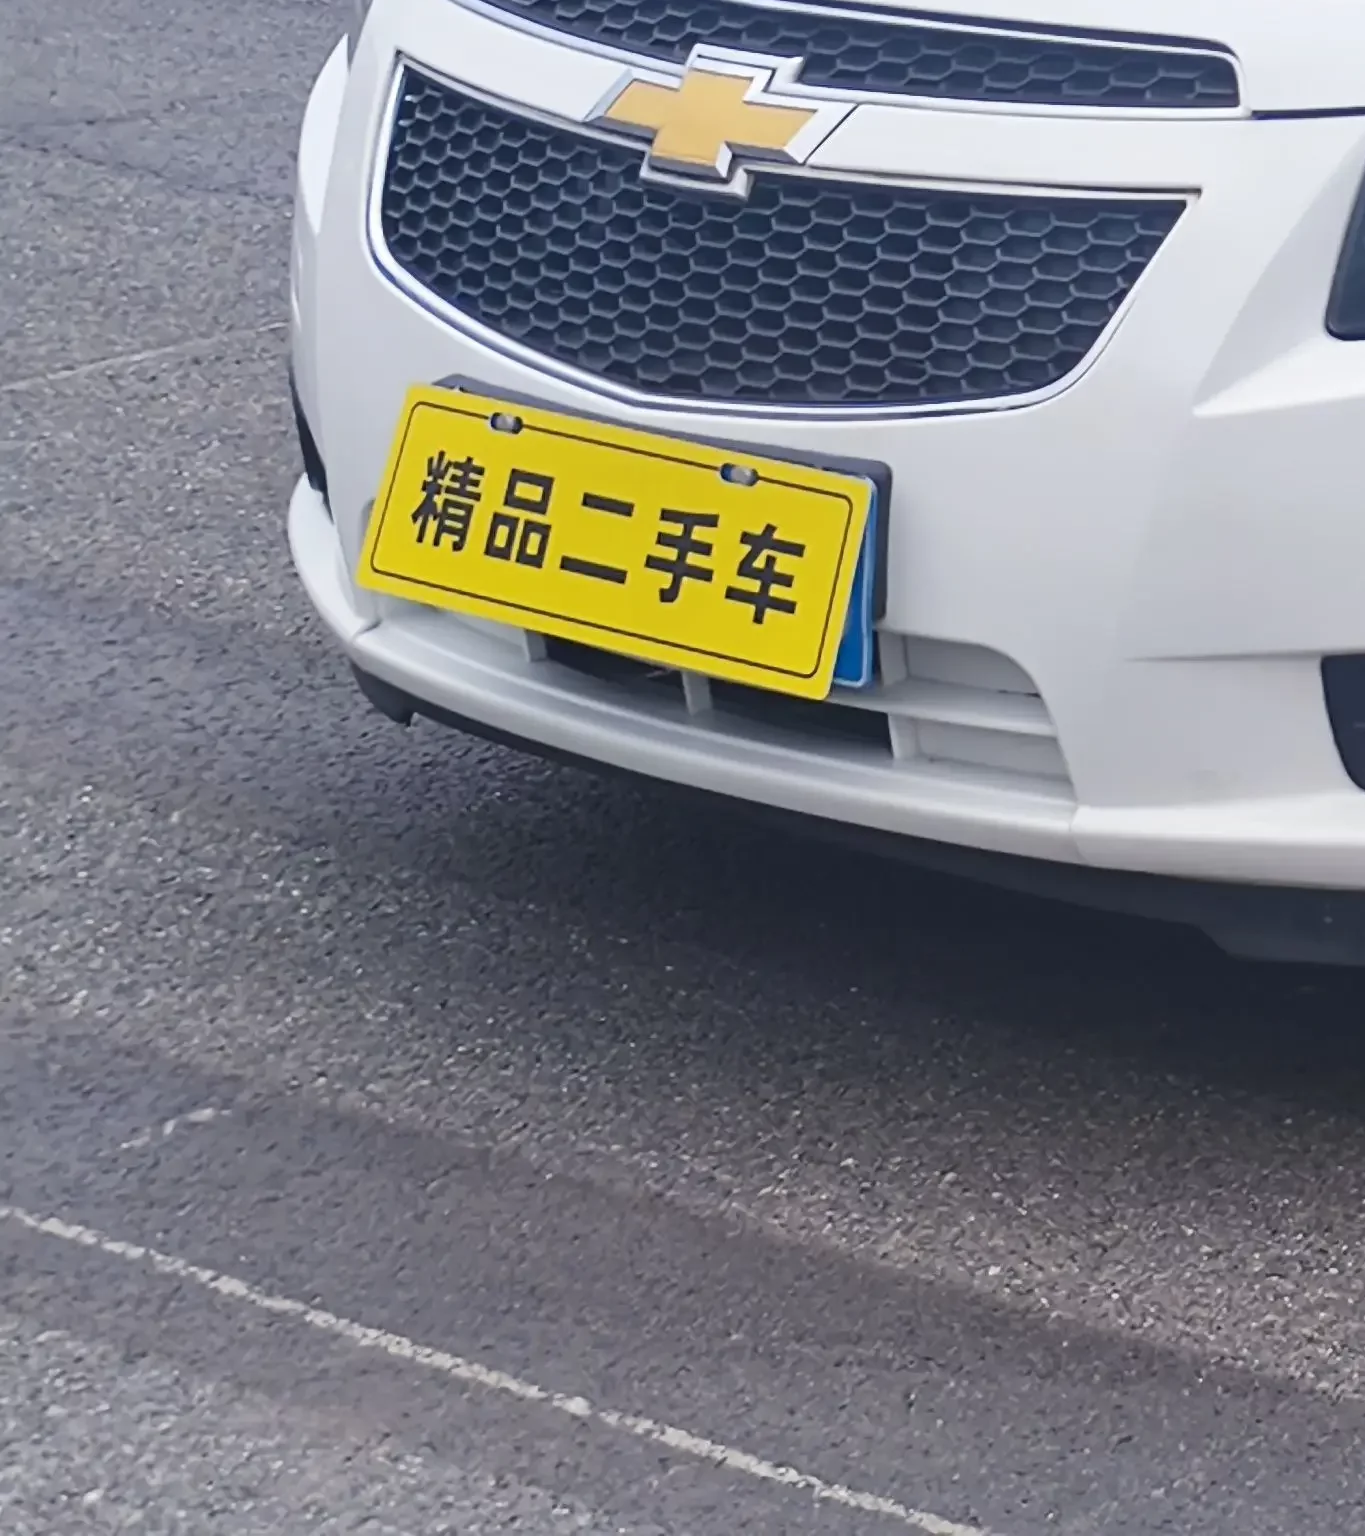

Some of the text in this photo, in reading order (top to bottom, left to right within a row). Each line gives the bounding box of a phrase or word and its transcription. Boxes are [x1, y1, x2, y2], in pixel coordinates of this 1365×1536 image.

[411, 449, 807, 625] 精品二手车
